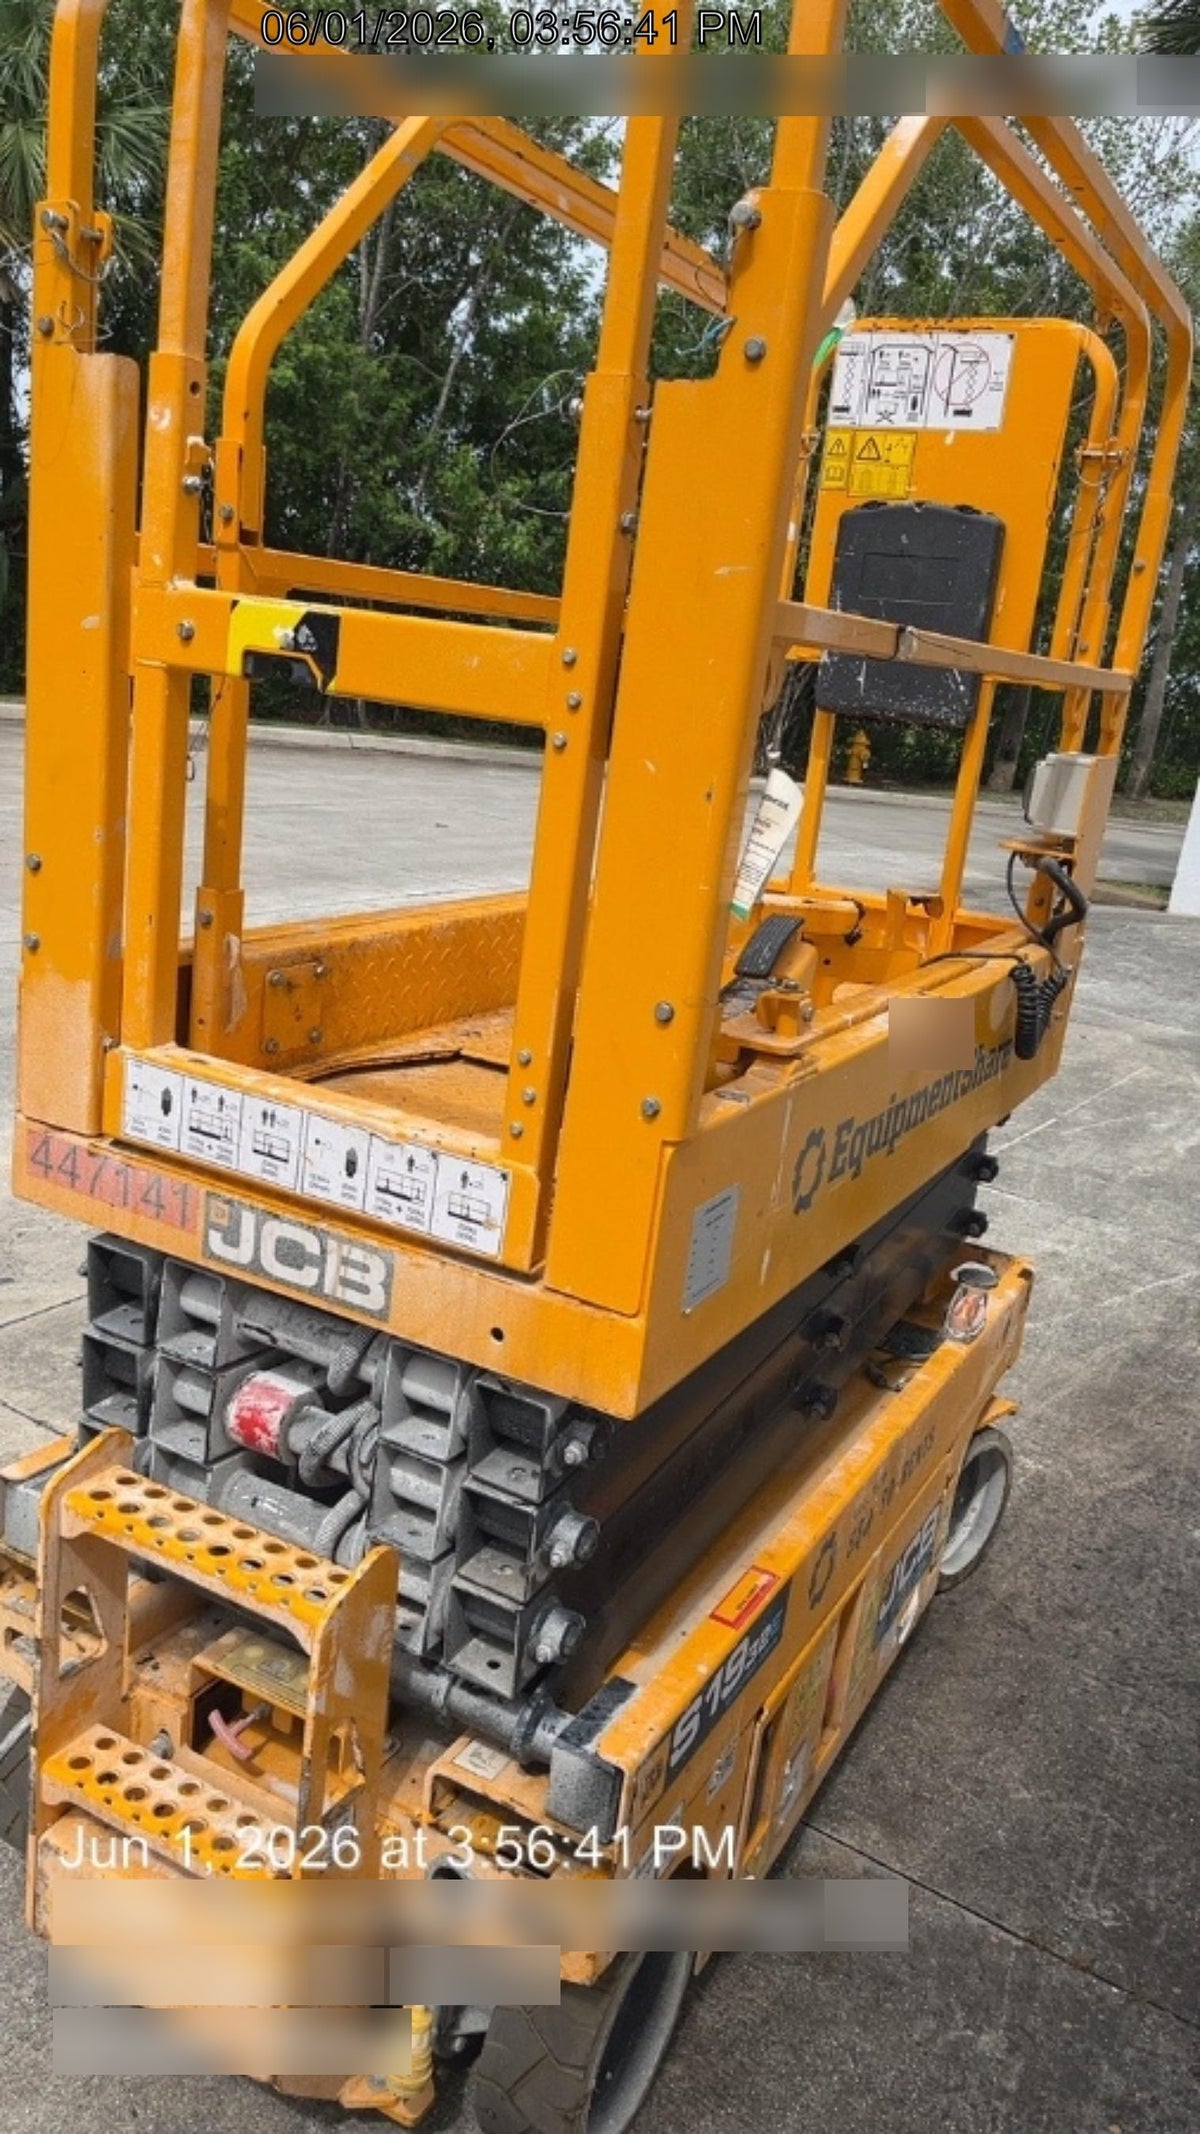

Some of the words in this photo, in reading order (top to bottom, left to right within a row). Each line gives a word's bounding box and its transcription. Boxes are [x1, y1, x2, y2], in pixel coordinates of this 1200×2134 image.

[30, 1132, 193, 1231] 447141
[206, 1206, 388, 1312] JCB
[879, 1502, 939, 1621] JCB
